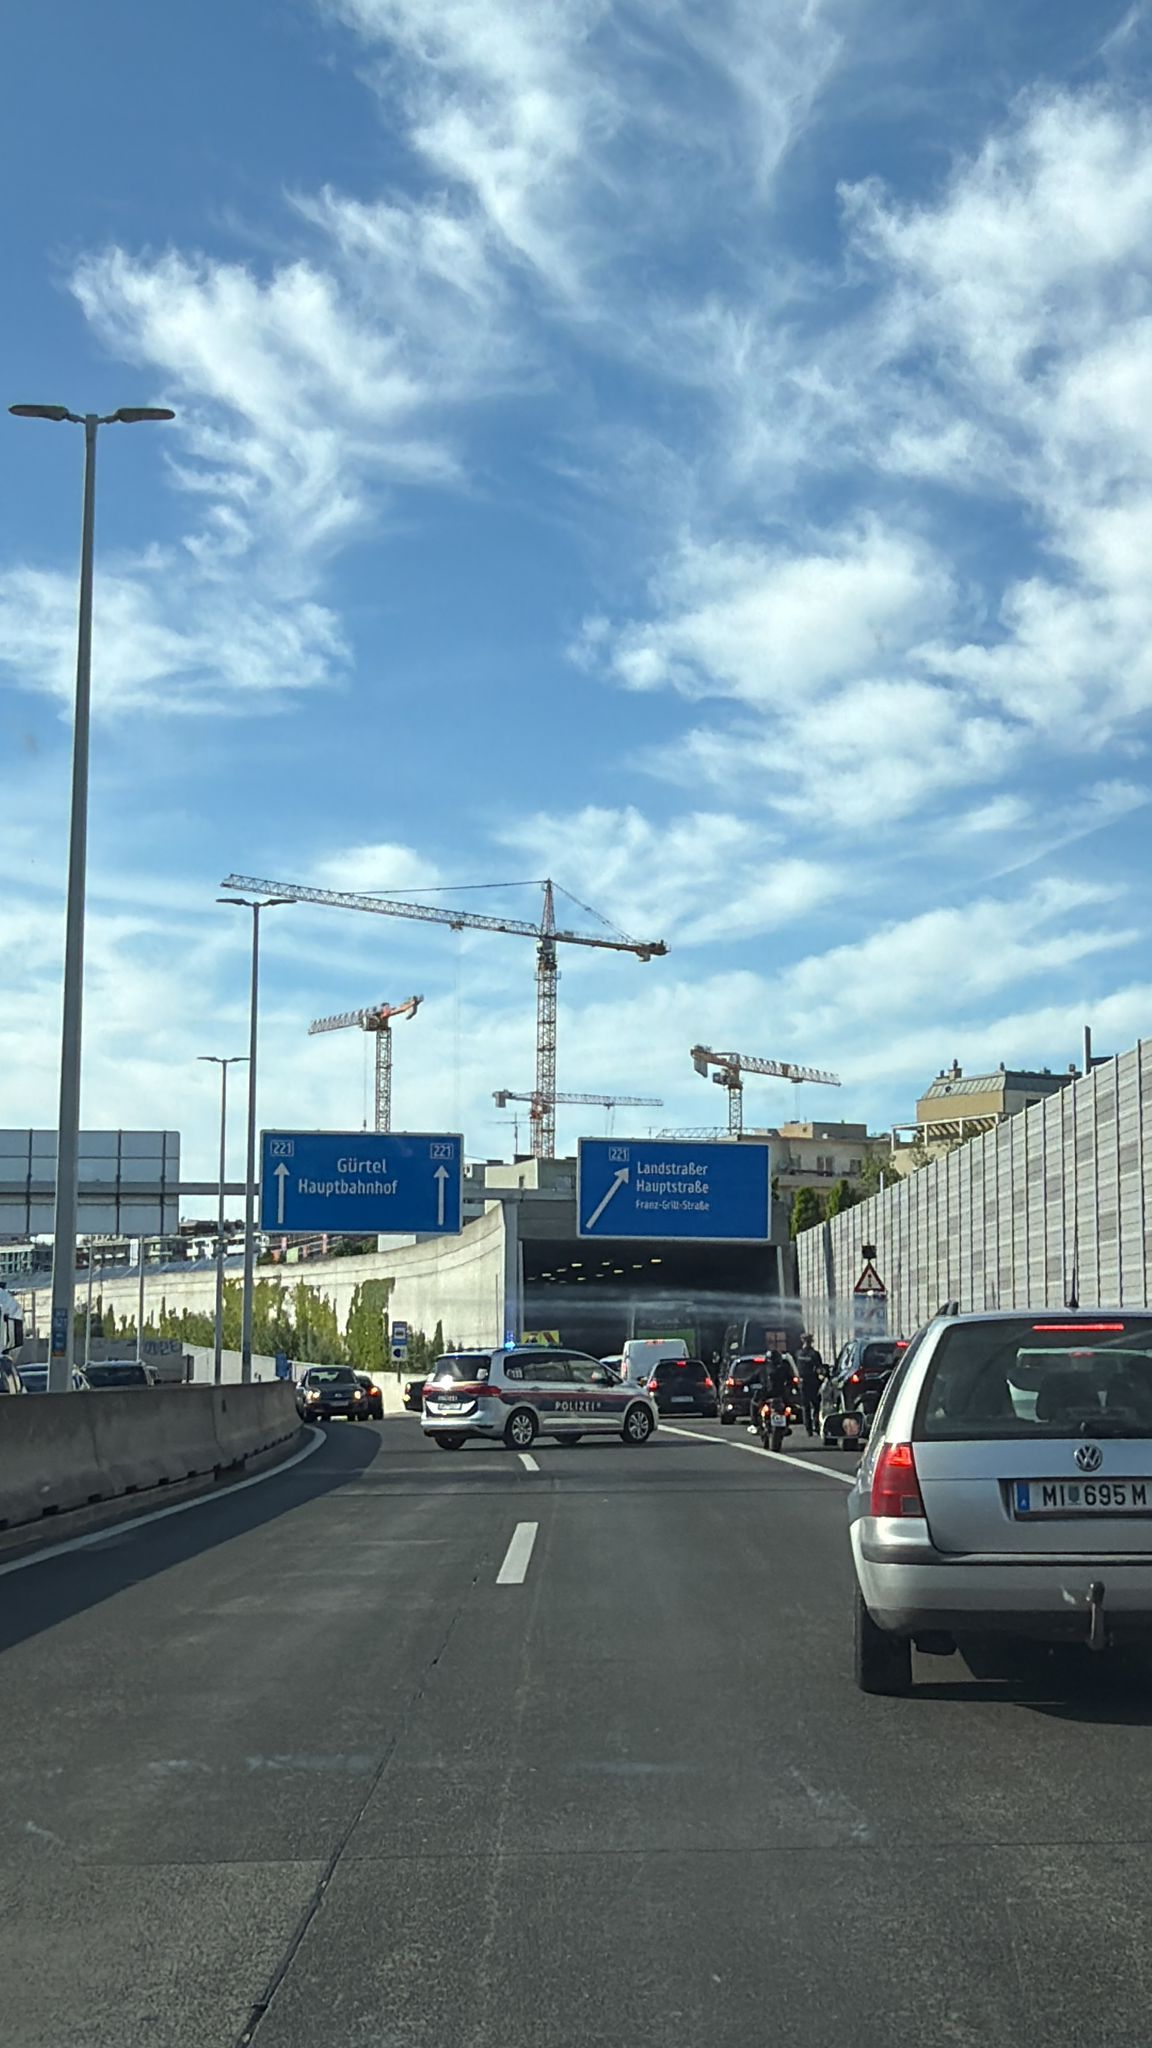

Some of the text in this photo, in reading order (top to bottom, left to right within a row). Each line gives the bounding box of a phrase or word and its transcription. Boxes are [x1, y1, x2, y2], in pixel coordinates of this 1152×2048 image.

[272, 1142, 292, 1154] 221
[433, 1145, 451, 1157] 221
[611, 1149, 628, 1159] 221
[337, 1157, 387, 1173] Gürtel
[637, 1161, 708, 1176] Landstraßer
[298, 1178, 399, 1197] Hauptbahnhof
[636, 1179, 710, 1195] Hauptstraße
[635, 1199, 711, 1212] Franz-Grill-Straße
[554, 1400, 595, 1411] POLIZEI
[1042, 1483, 1147, 1506] MI 695 M
